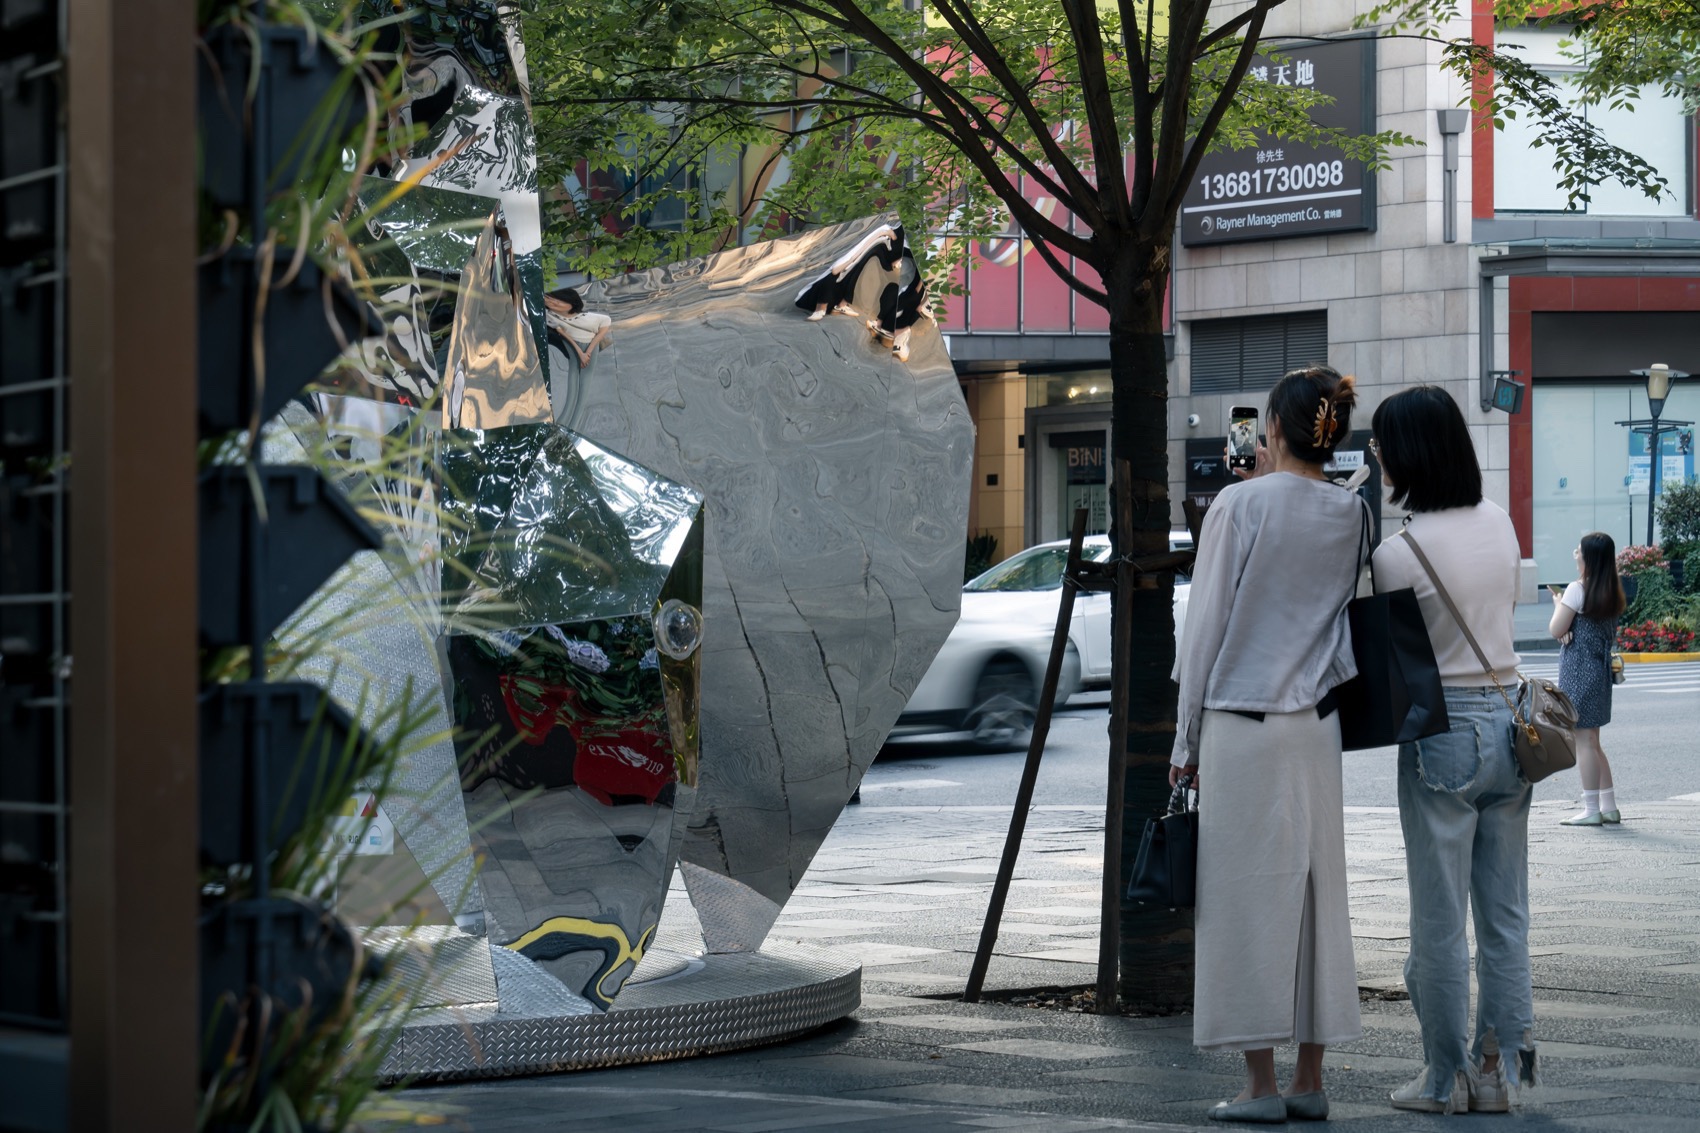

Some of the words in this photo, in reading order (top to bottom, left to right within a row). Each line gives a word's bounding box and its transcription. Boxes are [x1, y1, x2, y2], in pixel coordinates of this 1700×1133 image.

[1256, 148, 1285, 164] 徐先生
[1200, 160, 1343, 200] 13681730098
[1216, 214, 1246, 233] Rayner
[1247, 210, 1306, 228] Management
[1306, 207, 1321, 220] Co.
[645, 759, 664, 775] 119
